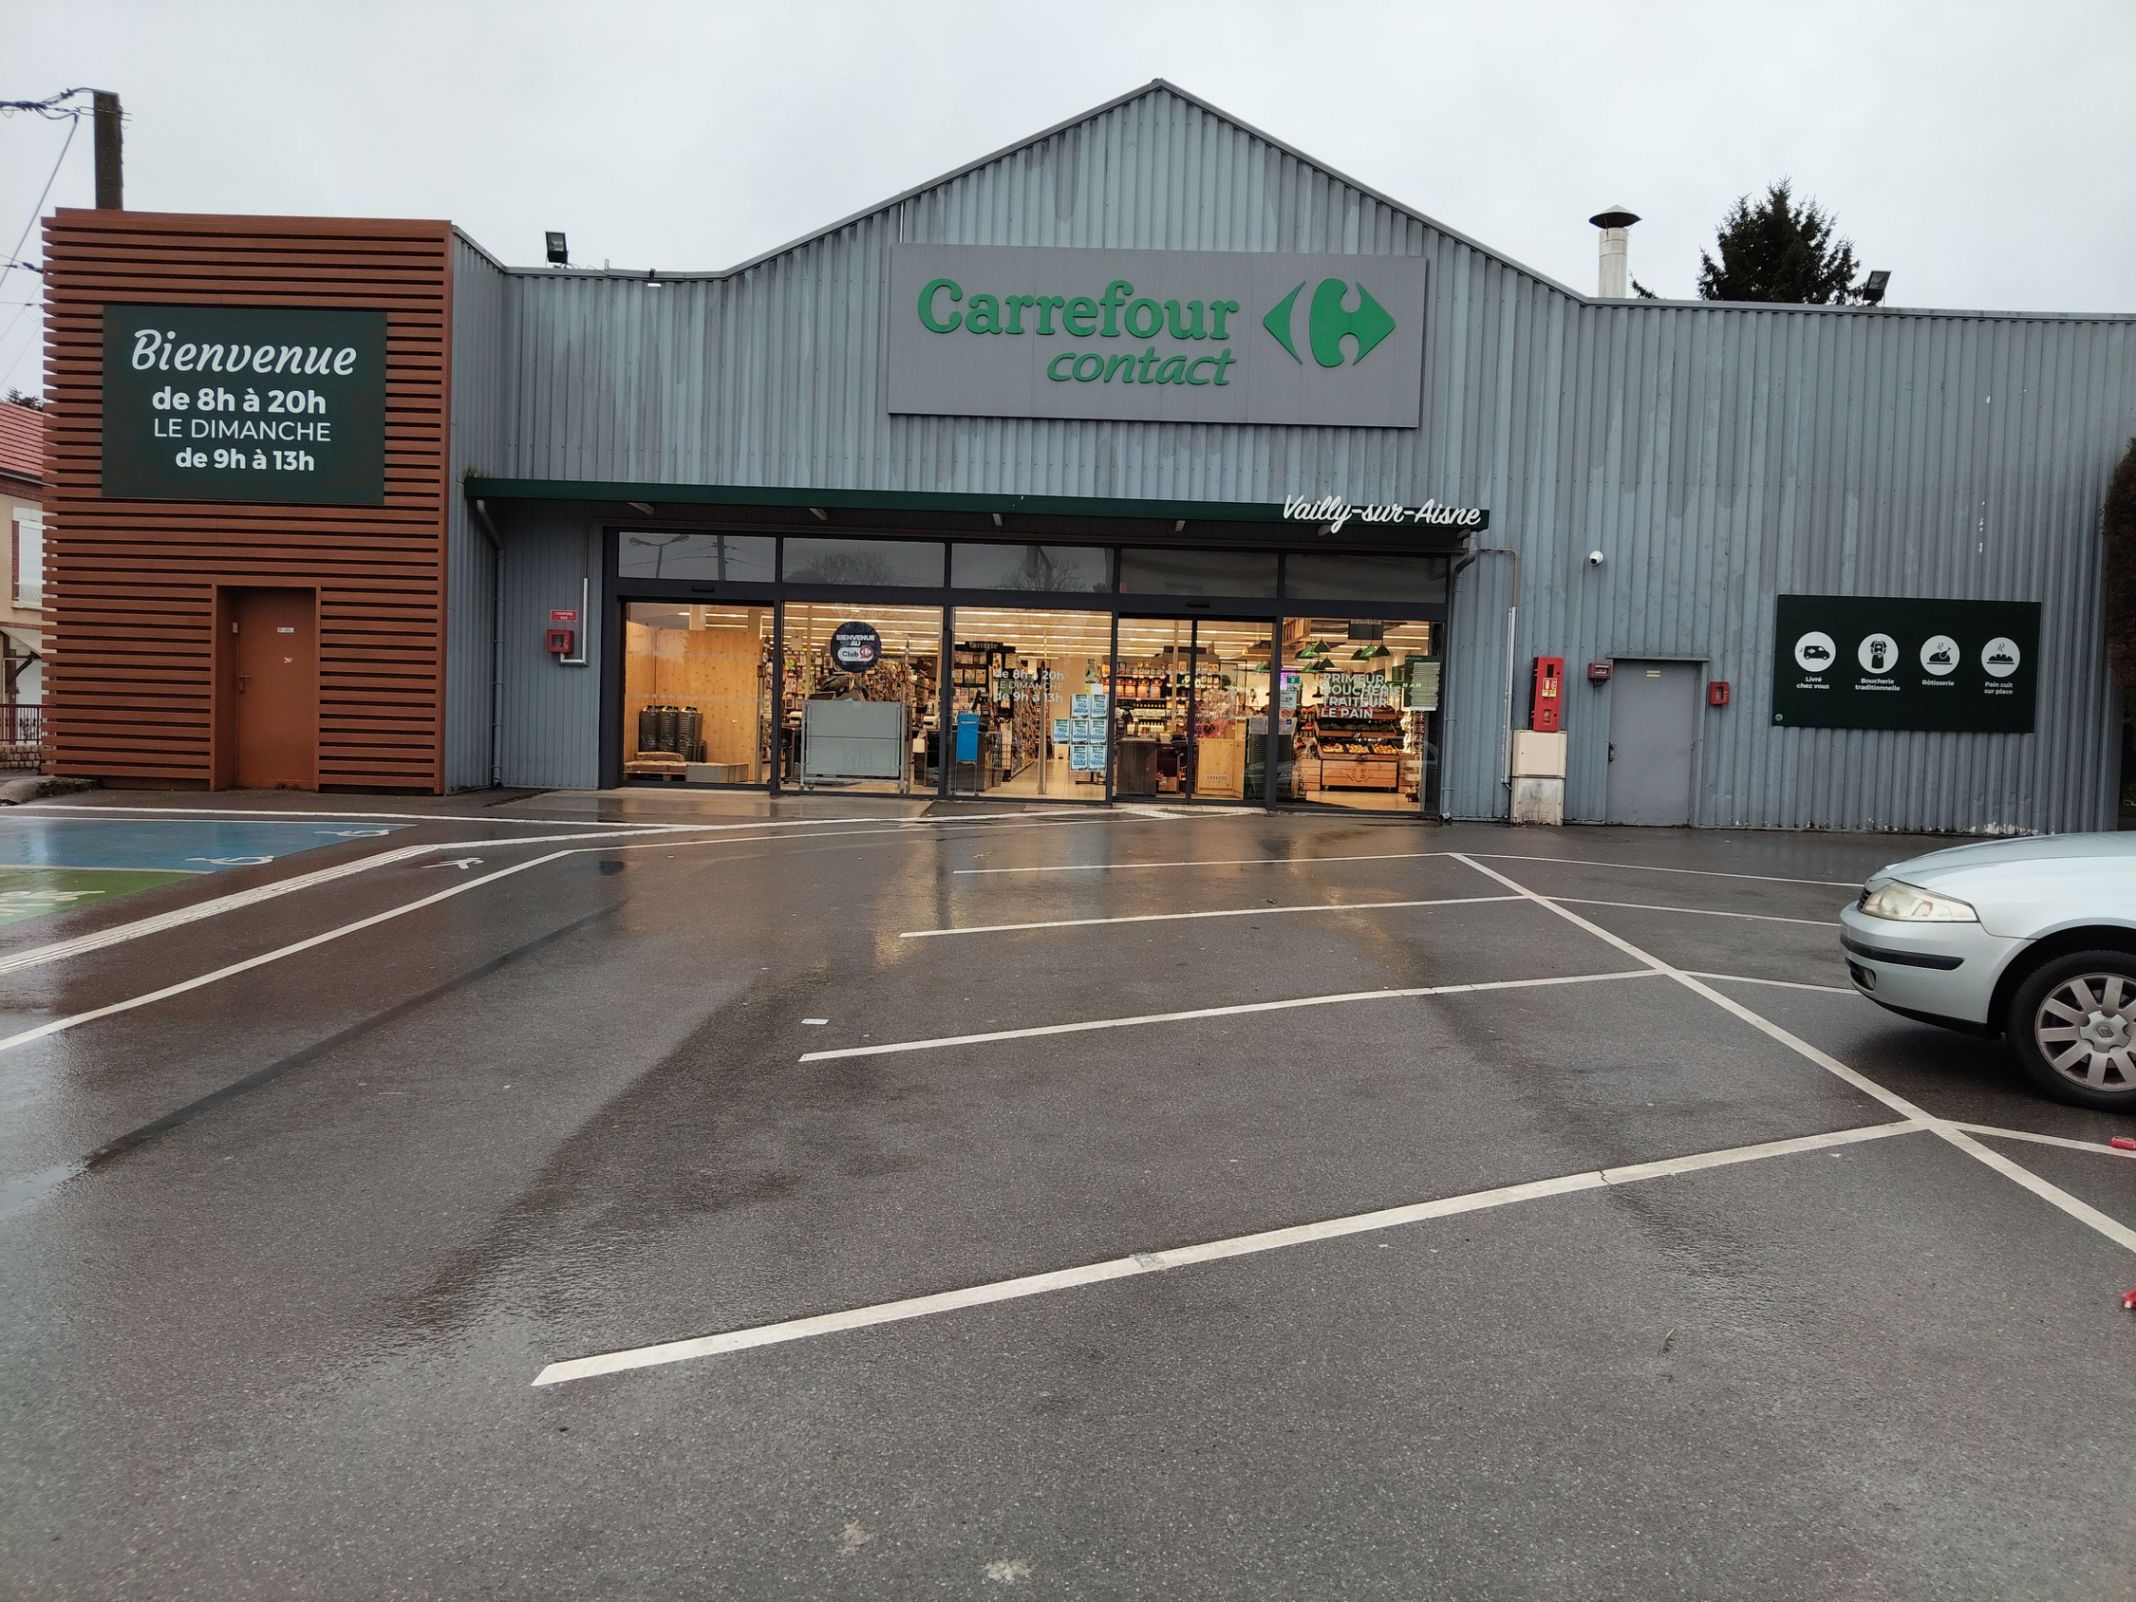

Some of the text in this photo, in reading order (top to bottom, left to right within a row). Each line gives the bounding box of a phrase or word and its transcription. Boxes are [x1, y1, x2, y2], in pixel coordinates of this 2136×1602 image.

[917, 278, 1240, 341] Carrefour
[131, 329, 357, 376] Bienvenue
[1047, 346, 1235, 387] contact
[152, 386, 326, 414] de 8h à 20h
[154, 418, 331, 442] LE DIMANCHE
[175, 446, 315, 471] de 9h à 13h
[1283, 493, 1481, 534] Vailly-sur-Aisne
[994, 670, 1009, 678] de
[1013, 670, 1028, 679] 8h
[1041, 671, 1064, 679] 20h
[1323, 673, 1385, 684] PRIMEUR
[1008, 681, 1063, 691] DIMANCHE
[1321, 684, 1401, 696] BOUCHERIE
[994, 692, 1009, 700] de
[1013, 692, 1028, 701] 9h
[1043, 693, 1063, 702] 13h
[1322, 696, 1387, 707] TRAITEUR
[1321, 707, 1373, 718] LE PAIN
